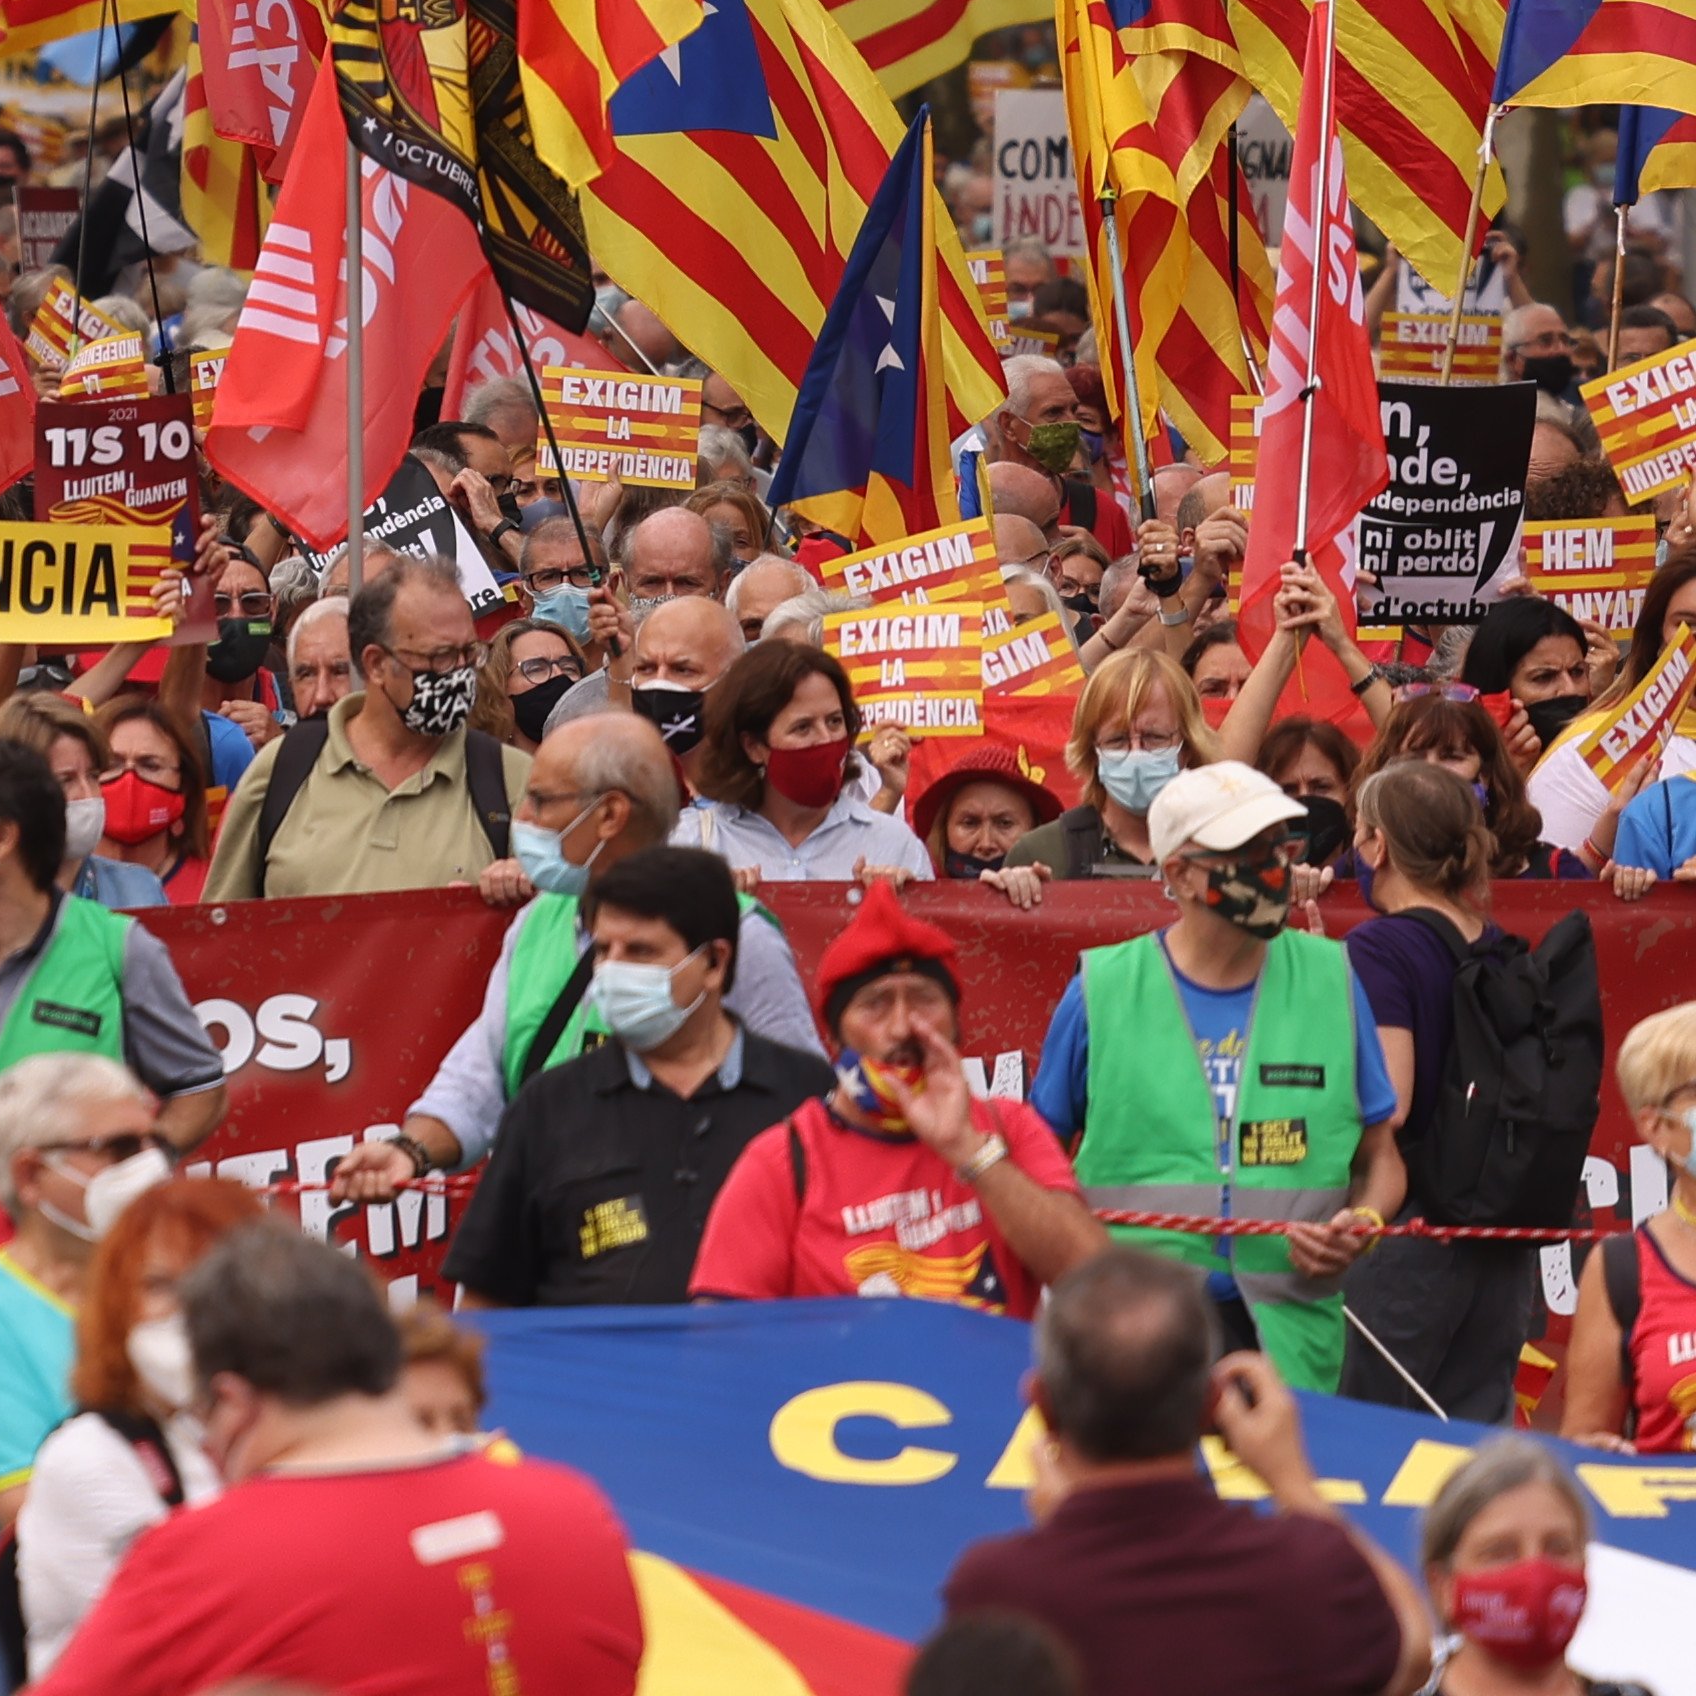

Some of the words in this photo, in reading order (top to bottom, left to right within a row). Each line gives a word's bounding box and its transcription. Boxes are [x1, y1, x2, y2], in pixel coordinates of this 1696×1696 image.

[561, 376, 682, 415] EXIGIM
[108, 407, 138, 422] 2021
[606, 416, 631, 441] LA
[63, 469, 126, 502] LLUITEM
[125, 477, 188, 508] GUANYEM
[1365, 527, 1393, 550] ni
[1404, 526, 1477, 551] oblit
[1541, 527, 1614, 571] HEM
[843, 532, 976, 598] EXIGIM
[1363, 551, 1389, 571] ni
[1396, 546, 1477, 578] perdó
[840, 613, 961, 657] EXIGIM
[880, 657, 905, 688] LA
[1599, 648, 1691, 765] EXIGIM
